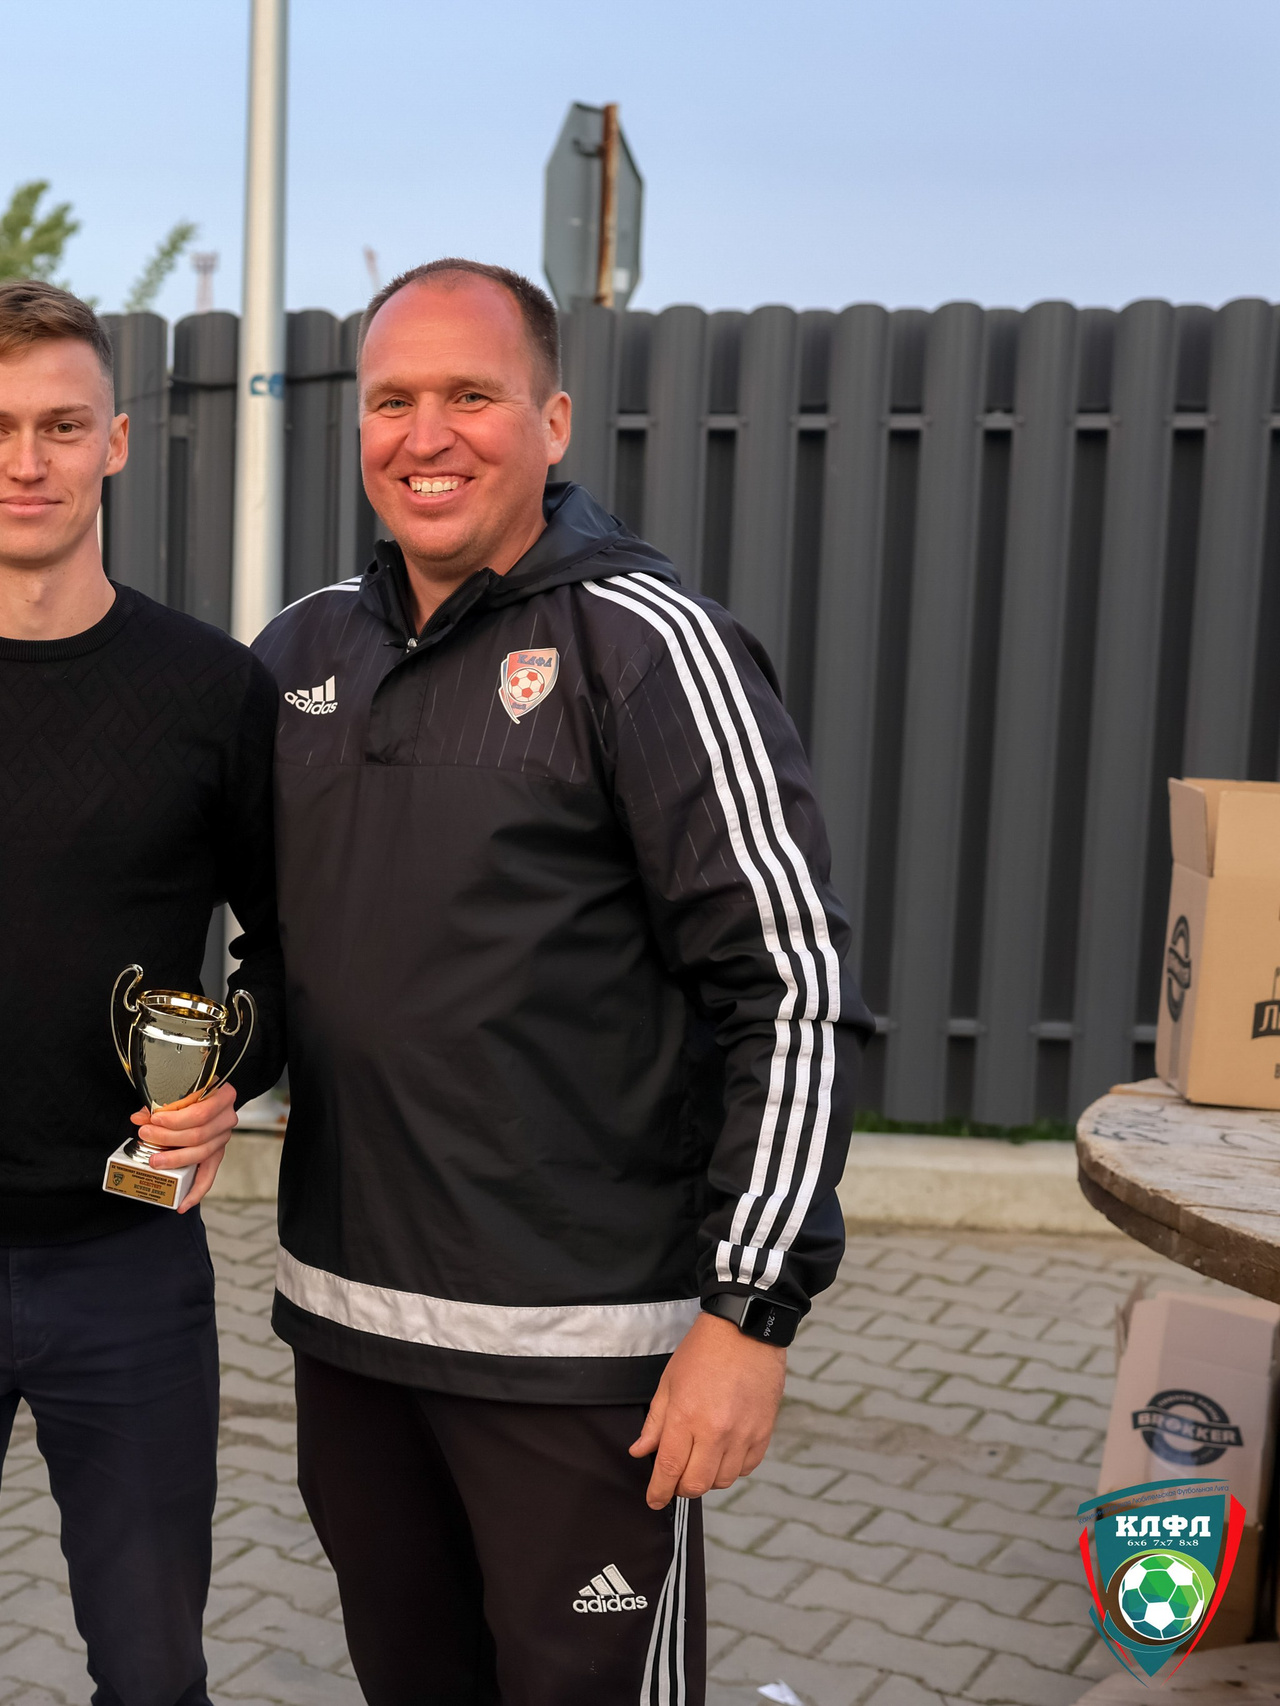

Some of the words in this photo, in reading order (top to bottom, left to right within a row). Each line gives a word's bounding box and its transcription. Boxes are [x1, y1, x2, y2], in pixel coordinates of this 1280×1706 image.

[284, 691, 339, 715] adidas
[763, 1316, 776, 1337] 20:46
[572, 1594, 649, 1613] adidas
